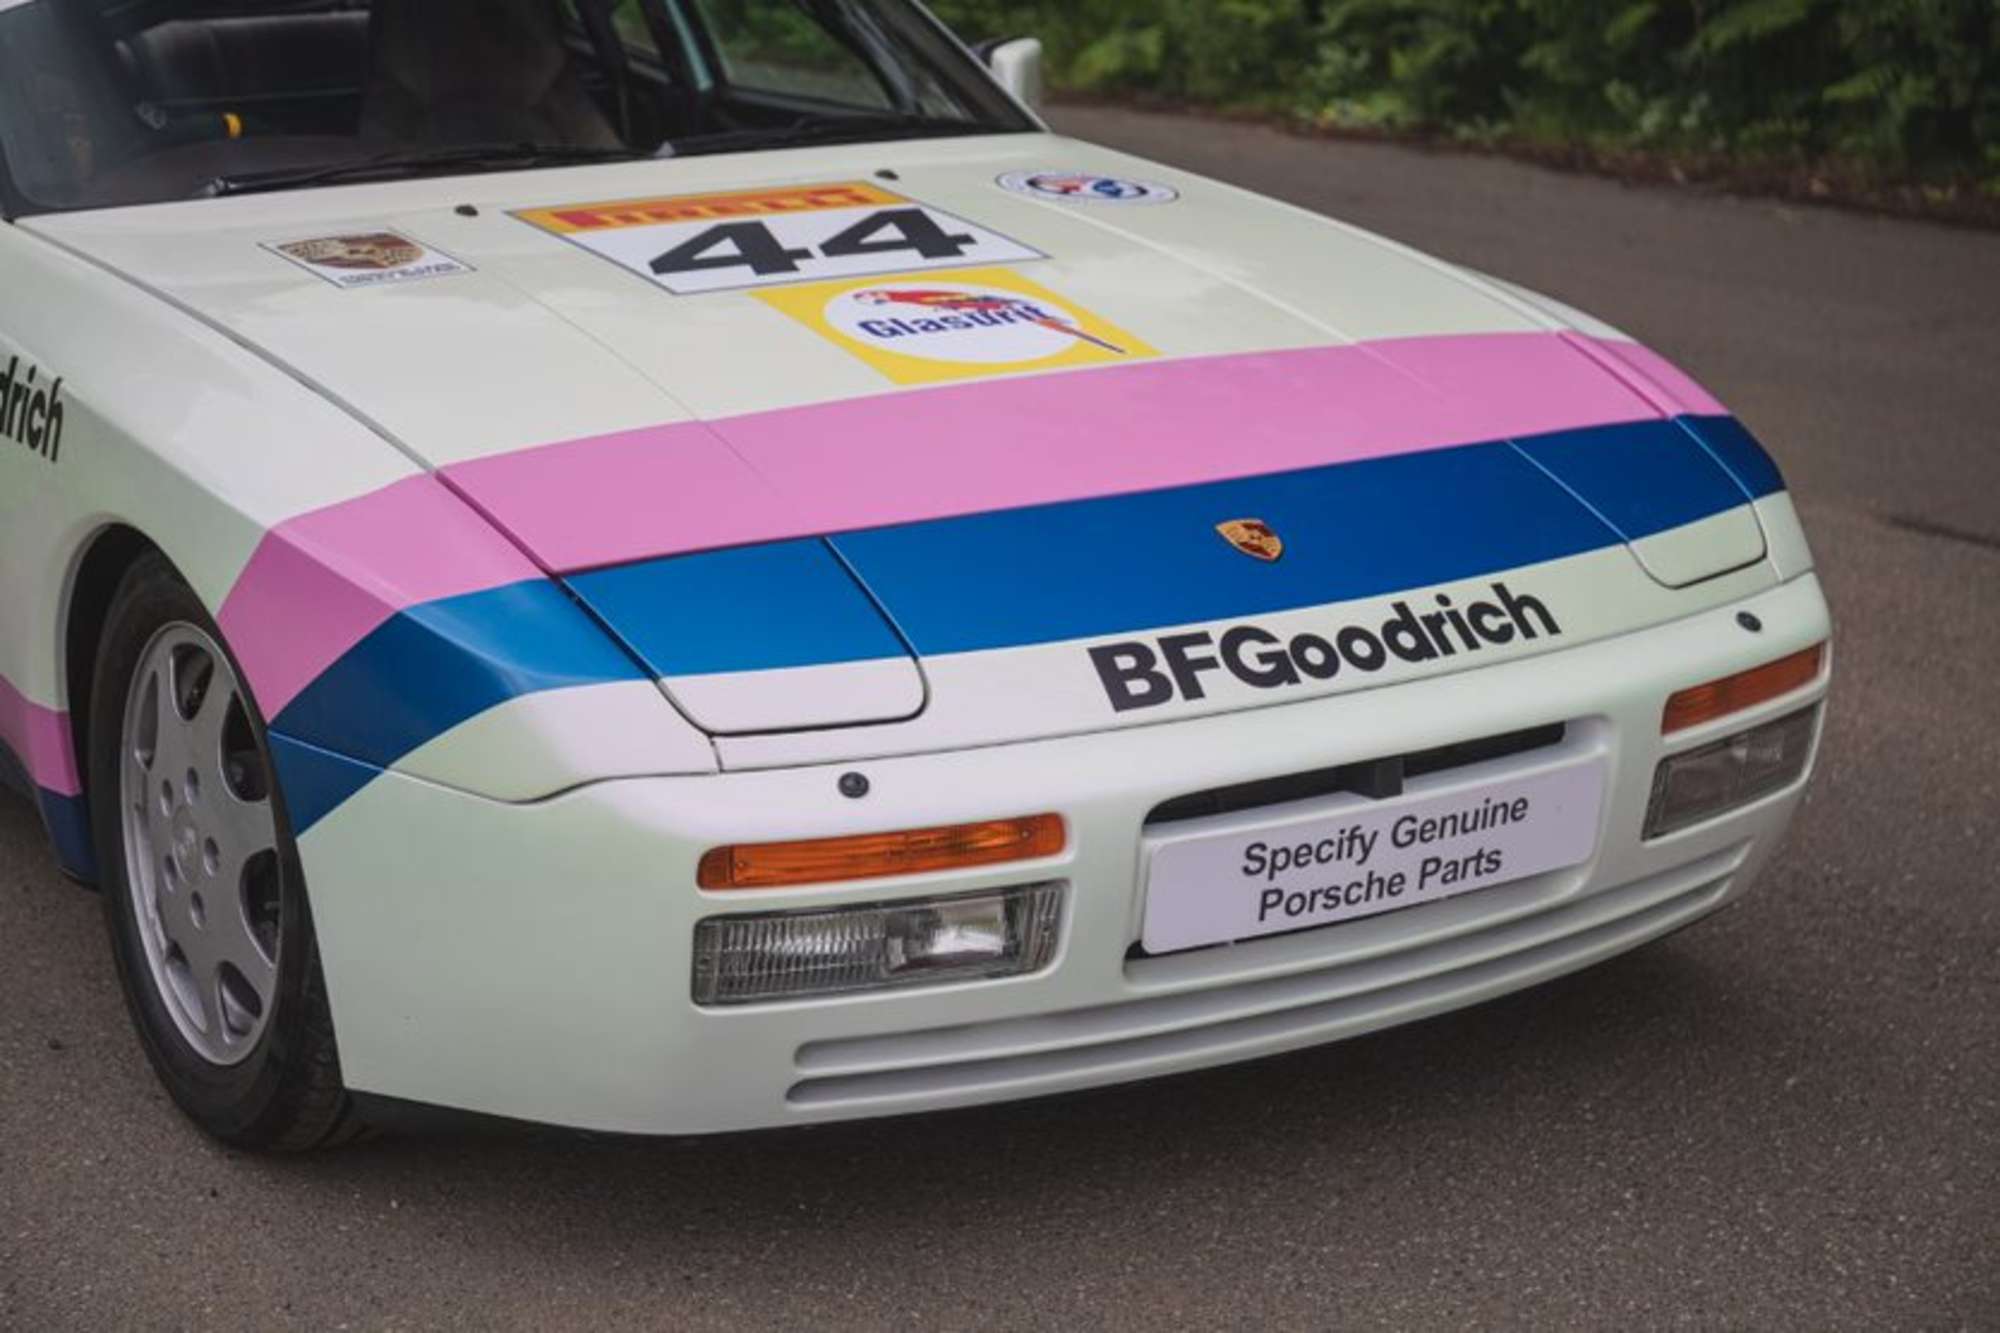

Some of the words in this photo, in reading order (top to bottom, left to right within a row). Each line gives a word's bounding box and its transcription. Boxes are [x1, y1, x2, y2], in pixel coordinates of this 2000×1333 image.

[648, 207, 976, 276] 44
[857, 302, 1053, 338] Glasurit
[1087, 582, 1561, 713] BFGoodrich
[1242, 825, 1378, 880] Specify
[1390, 796, 1529, 849] Genuine
[1258, 870, 1406, 922] Porsche
[1418, 847, 1502, 890] Parts
